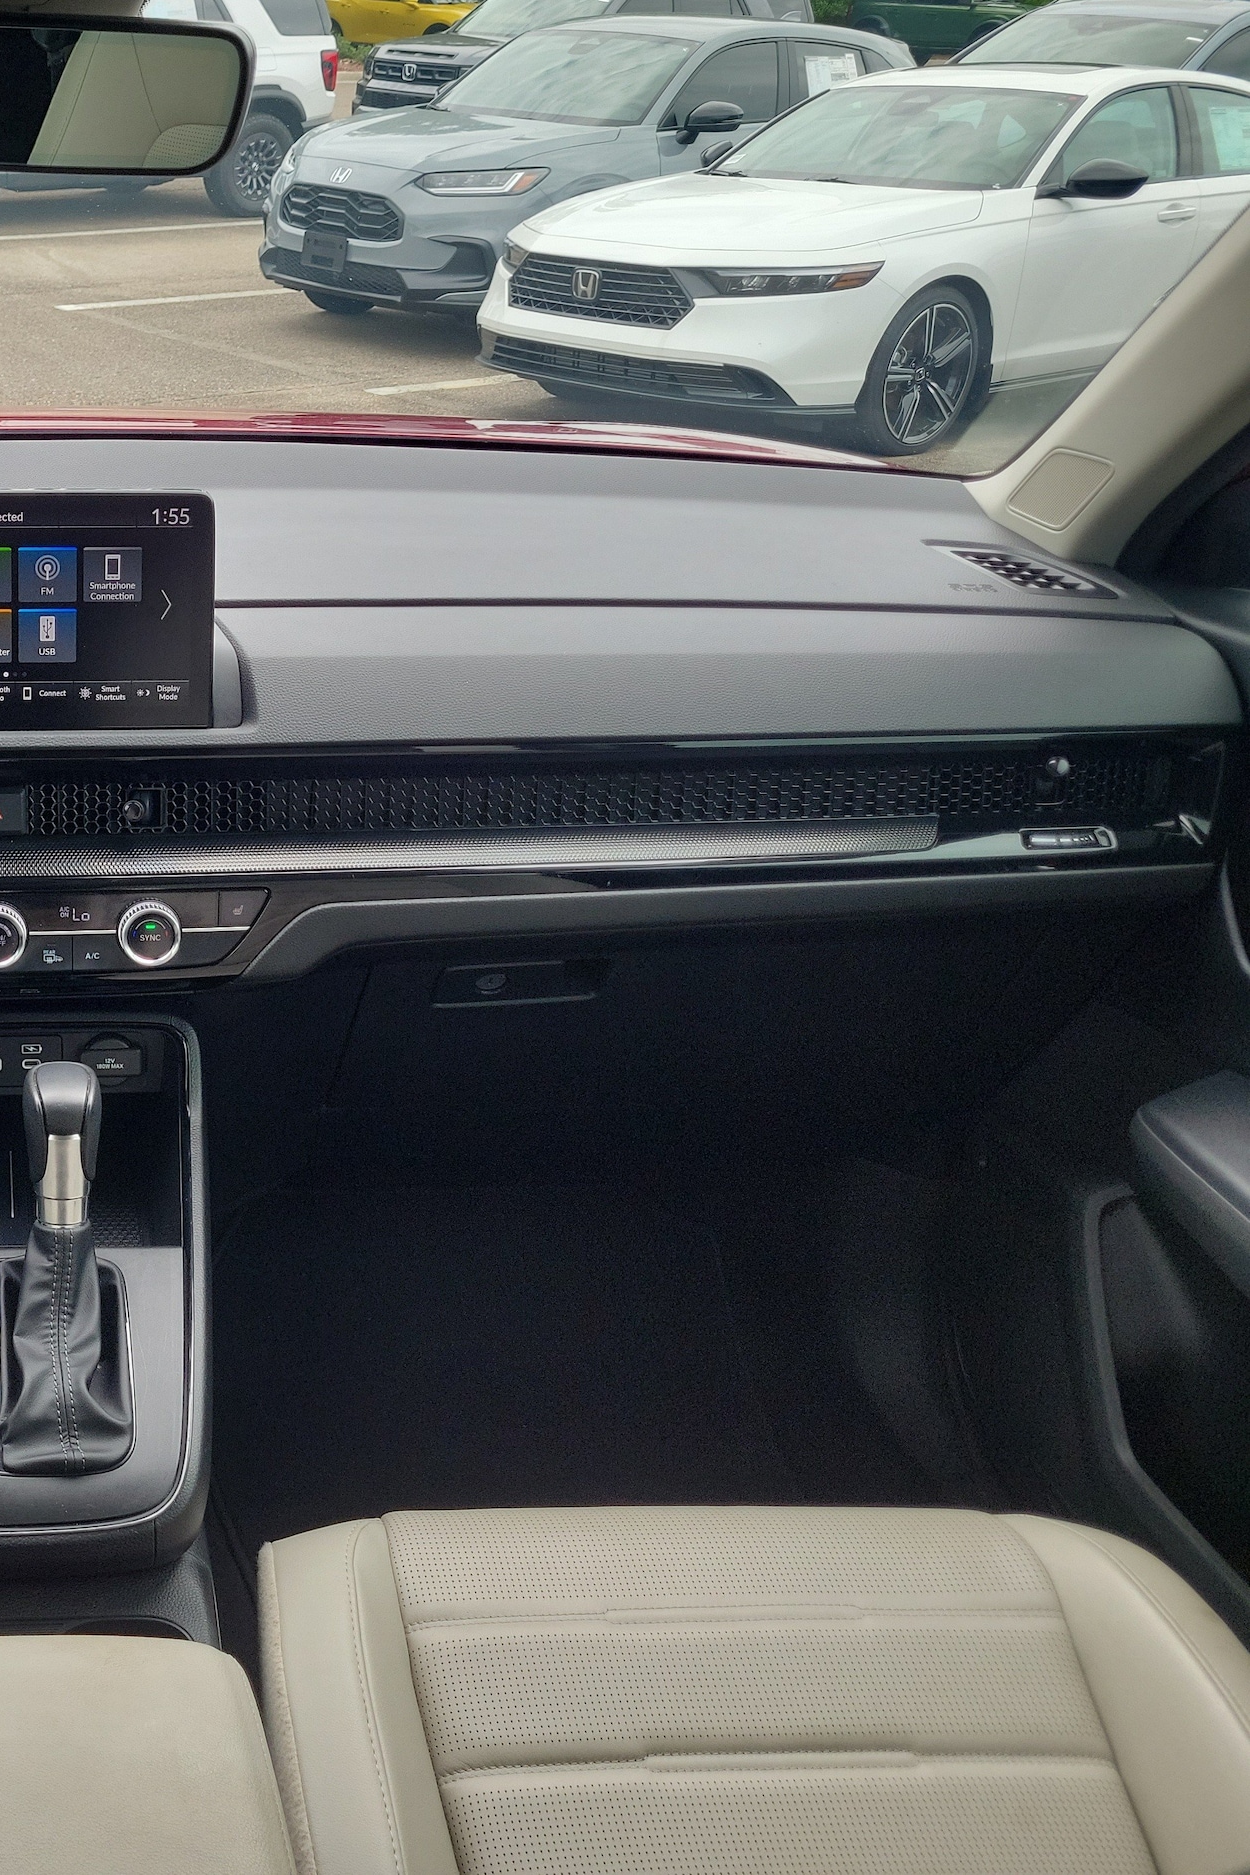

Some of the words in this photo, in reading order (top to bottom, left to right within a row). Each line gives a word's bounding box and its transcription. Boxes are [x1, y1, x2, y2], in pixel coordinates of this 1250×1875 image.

[151, 508, 190, 525] 1:55
[89, 581, 136, 591] Smartphone
[40, 587, 54, 596] FM
[90, 592, 135, 601] Connection
[38, 648, 56, 656] USB
[100, 685, 120, 693] Smart
[156, 685, 180, 694] Display
[95, 693, 126, 701] Shortcuts
[72, 908, 91, 921] Lo
[139, 934, 162, 942] SYNC
[84, 952, 100, 960] A/C
